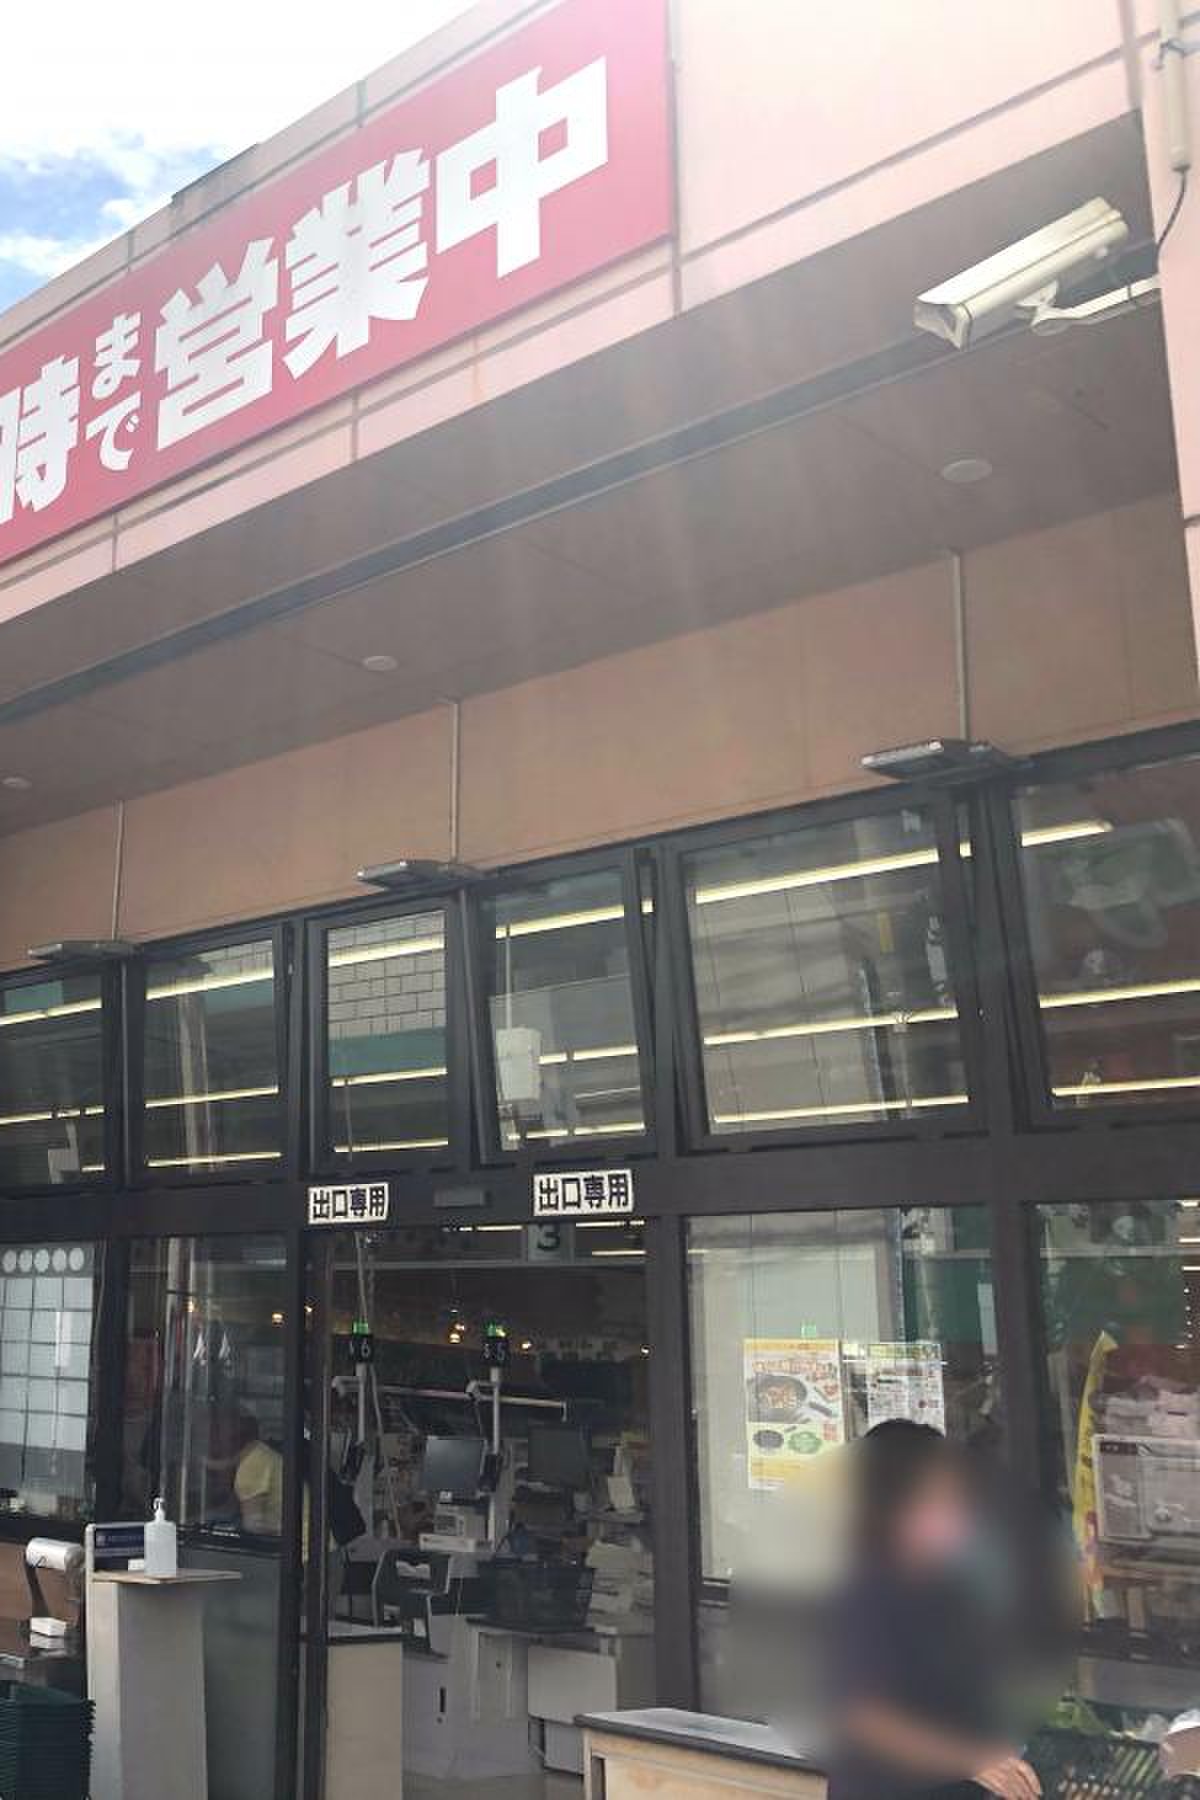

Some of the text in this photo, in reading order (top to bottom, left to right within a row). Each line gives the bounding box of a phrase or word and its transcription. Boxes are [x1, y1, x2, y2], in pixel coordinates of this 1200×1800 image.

[312, 1185, 386, 1219] 出口専用
[538, 1173, 629, 1214] 出口専用
